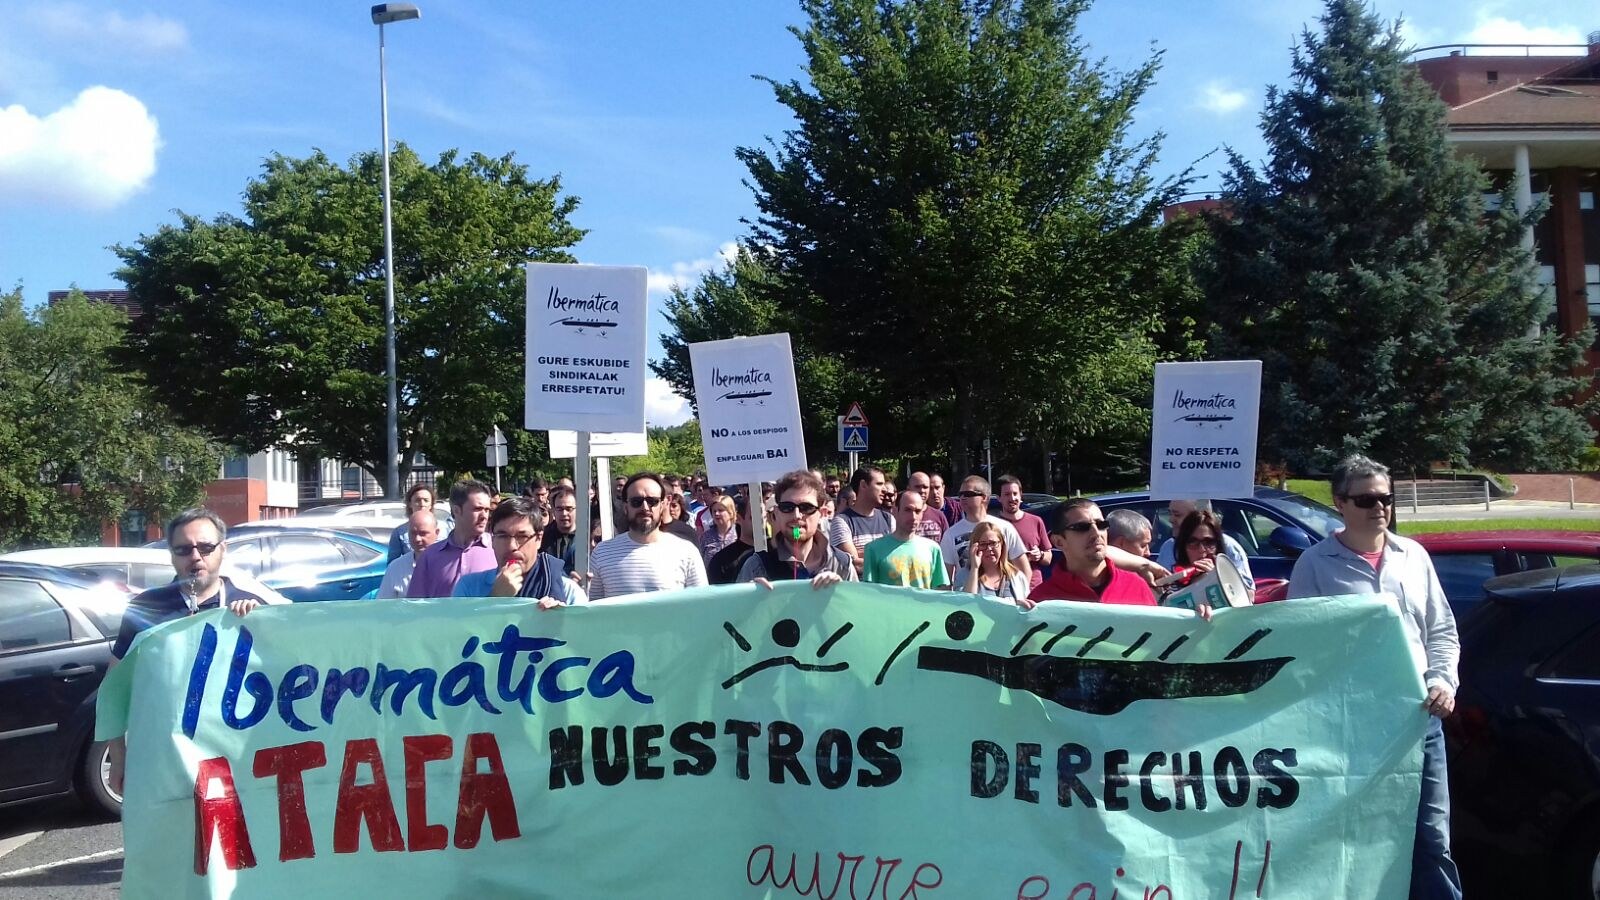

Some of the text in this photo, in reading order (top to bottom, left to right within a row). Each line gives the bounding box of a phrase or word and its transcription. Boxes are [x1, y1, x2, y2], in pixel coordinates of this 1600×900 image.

[547, 285, 620, 314] Ibermática
[537, 356, 631, 369] GURE ESKUBIDE
[548, 370, 619, 382] SINDIKALAK
[711, 367, 772, 388] Ibermática
[541, 383, 626, 396] ERRESPETATU!
[1172, 388, 1236, 410] Ibermática
[711, 428, 729, 438] NO
[753, 426, 788, 435] DESPIDOS
[716, 448, 788, 463] ENPLEGUARI BAI
[1165, 447, 1240, 456] NO RESPETA
[1161, 460, 1242, 470] EL CONVENIO
[182, 622, 654, 739] Ibermática
[193, 719, 1300, 876] ATACA NUESTROS DERECHOS
[747, 844, 943, 900] aurre
